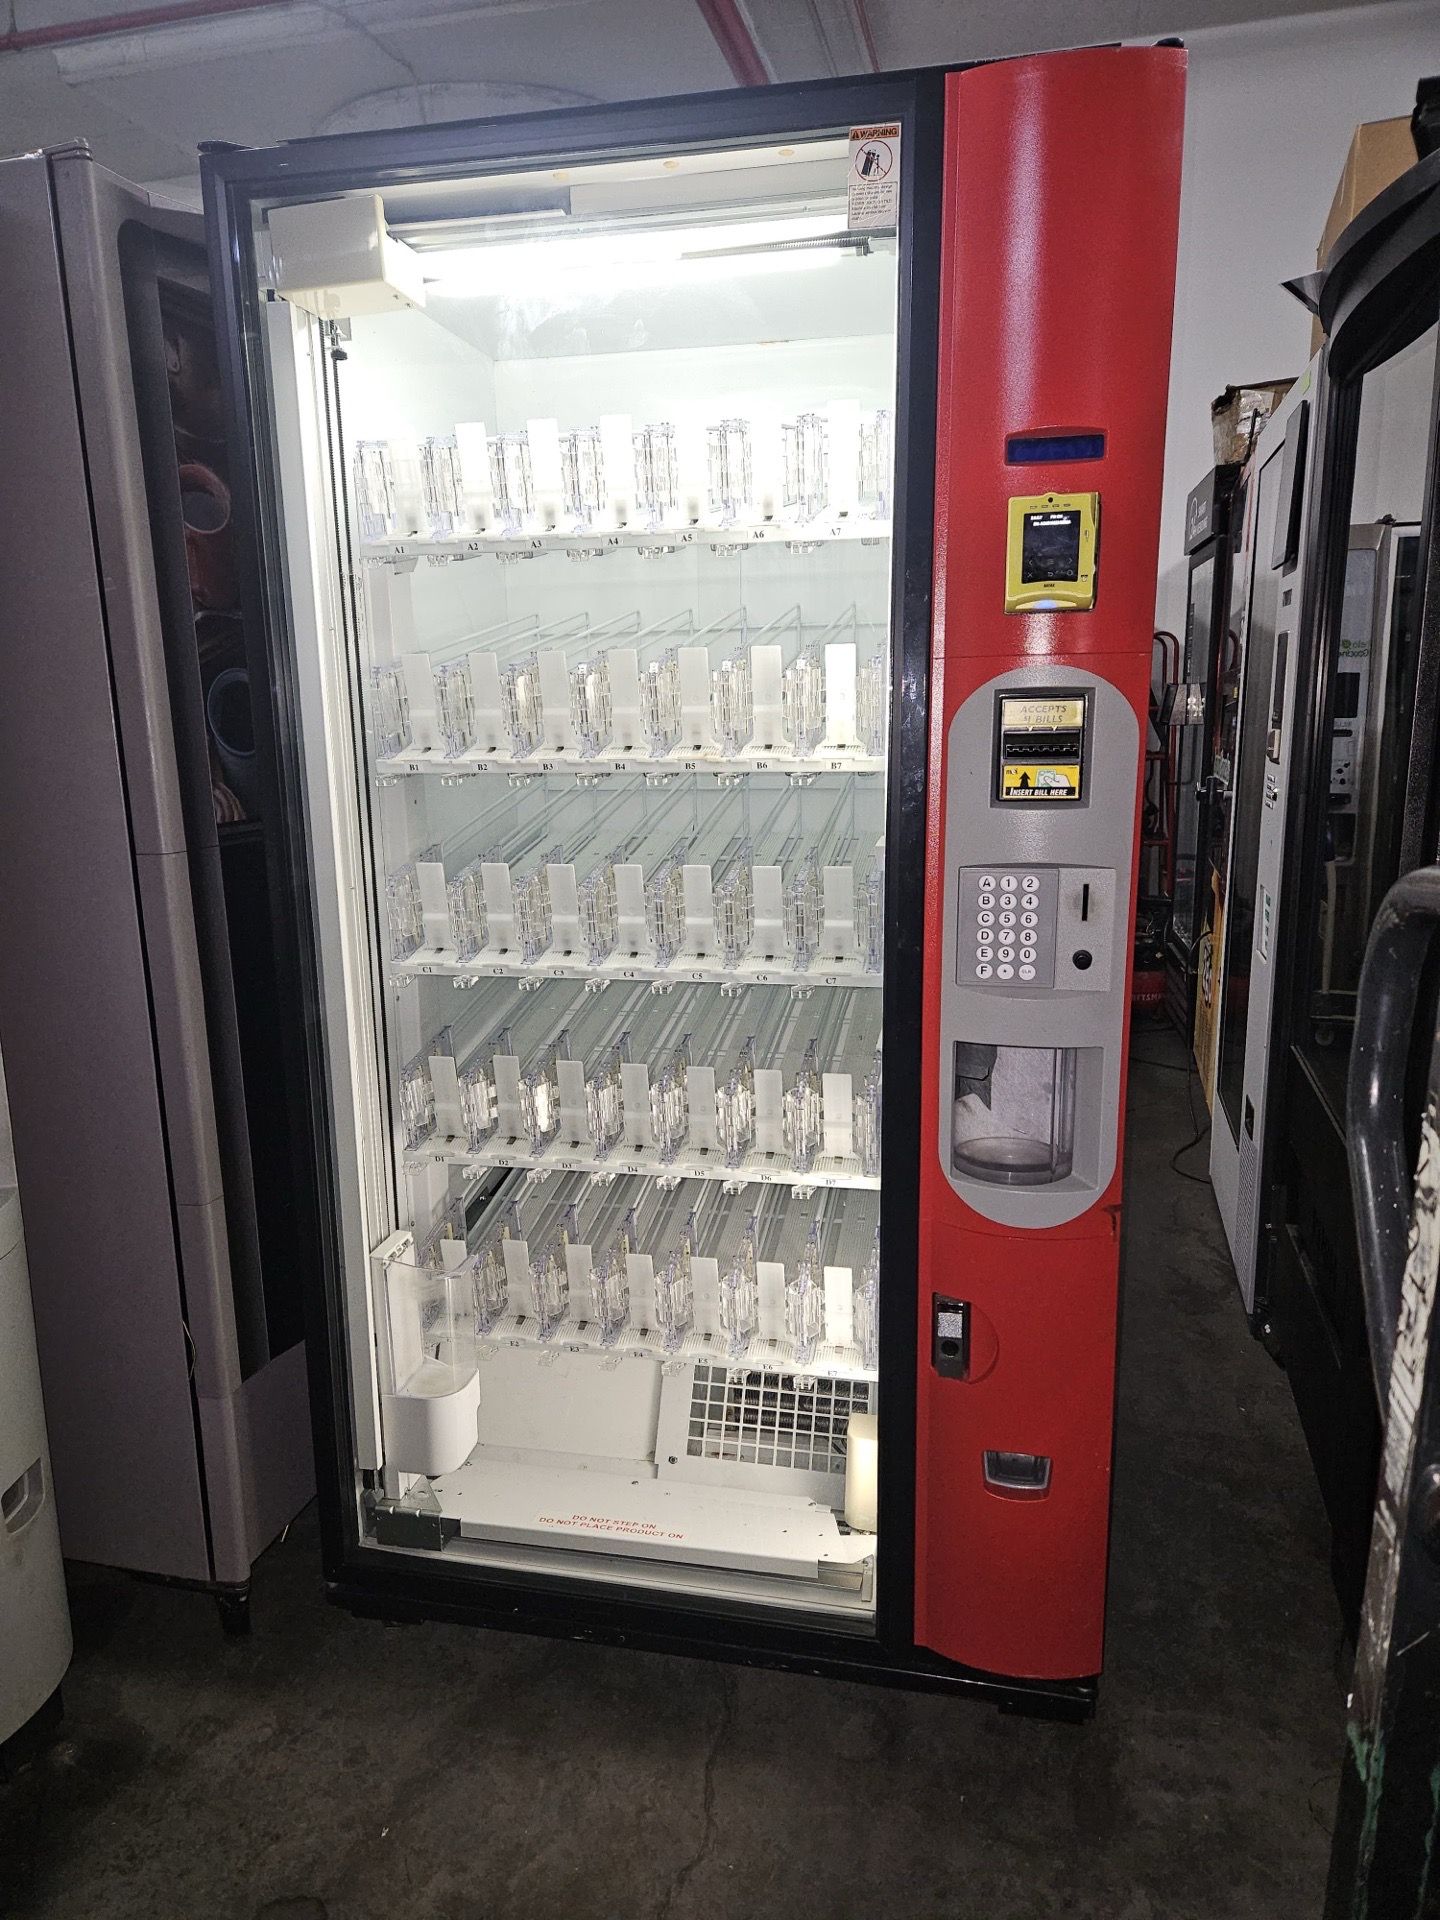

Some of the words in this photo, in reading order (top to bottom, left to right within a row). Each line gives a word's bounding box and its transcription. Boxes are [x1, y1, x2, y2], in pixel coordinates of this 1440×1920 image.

[860, 128, 897, 138] WARNING
[531, 540, 542, 549] A3
[607, 537, 618, 545] A4
[681, 534, 692, 542] A5
[753, 531, 764, 539] A6
[829, 528, 841, 536] A7
[1020, 705, 1067, 714] ACCEPTS
[1036, 715, 1063, 724] BILLS
[1010, 788, 1034, 796] INSERT
[983, 879, 991, 888] A
[1027, 879, 1034, 888] 2
[982, 896, 990, 905] B
[1004, 897, 1011, 905] 3
[1026, 897, 1033, 905] 4
[981, 914, 990, 923] C
[1004, 914, 1010, 923] 5
[1025, 915, 1032, 923] 6
[981, 932, 989, 940] D
[1003, 932, 1010, 940] 7
[1024, 932, 1031, 941] 8
[981, 949, 988, 957] E
[1002, 949, 1009, 958] 9
[1024, 950, 1030, 958] 0
[980, 966, 988, 974] F
[580, 1522, 614, 1531] PLACE
[615, 1526, 666, 1537] PRODUCT
